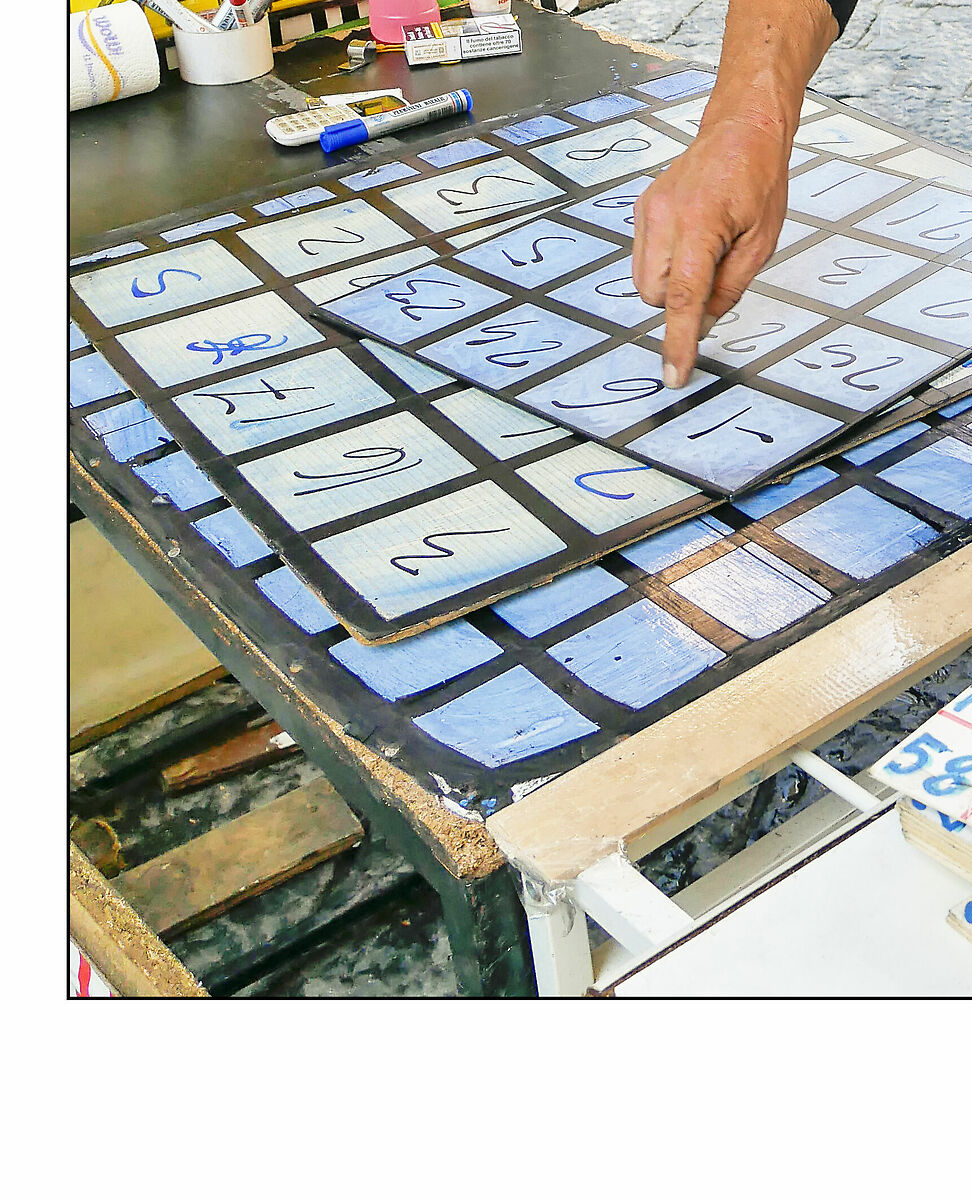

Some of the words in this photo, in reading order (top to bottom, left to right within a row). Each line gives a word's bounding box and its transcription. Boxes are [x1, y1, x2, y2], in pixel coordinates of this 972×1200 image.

[493, 34, 514, 42] tabacco
[462, 46, 486, 55] sostanze
[486, 43, 519, 52] cancerogene
